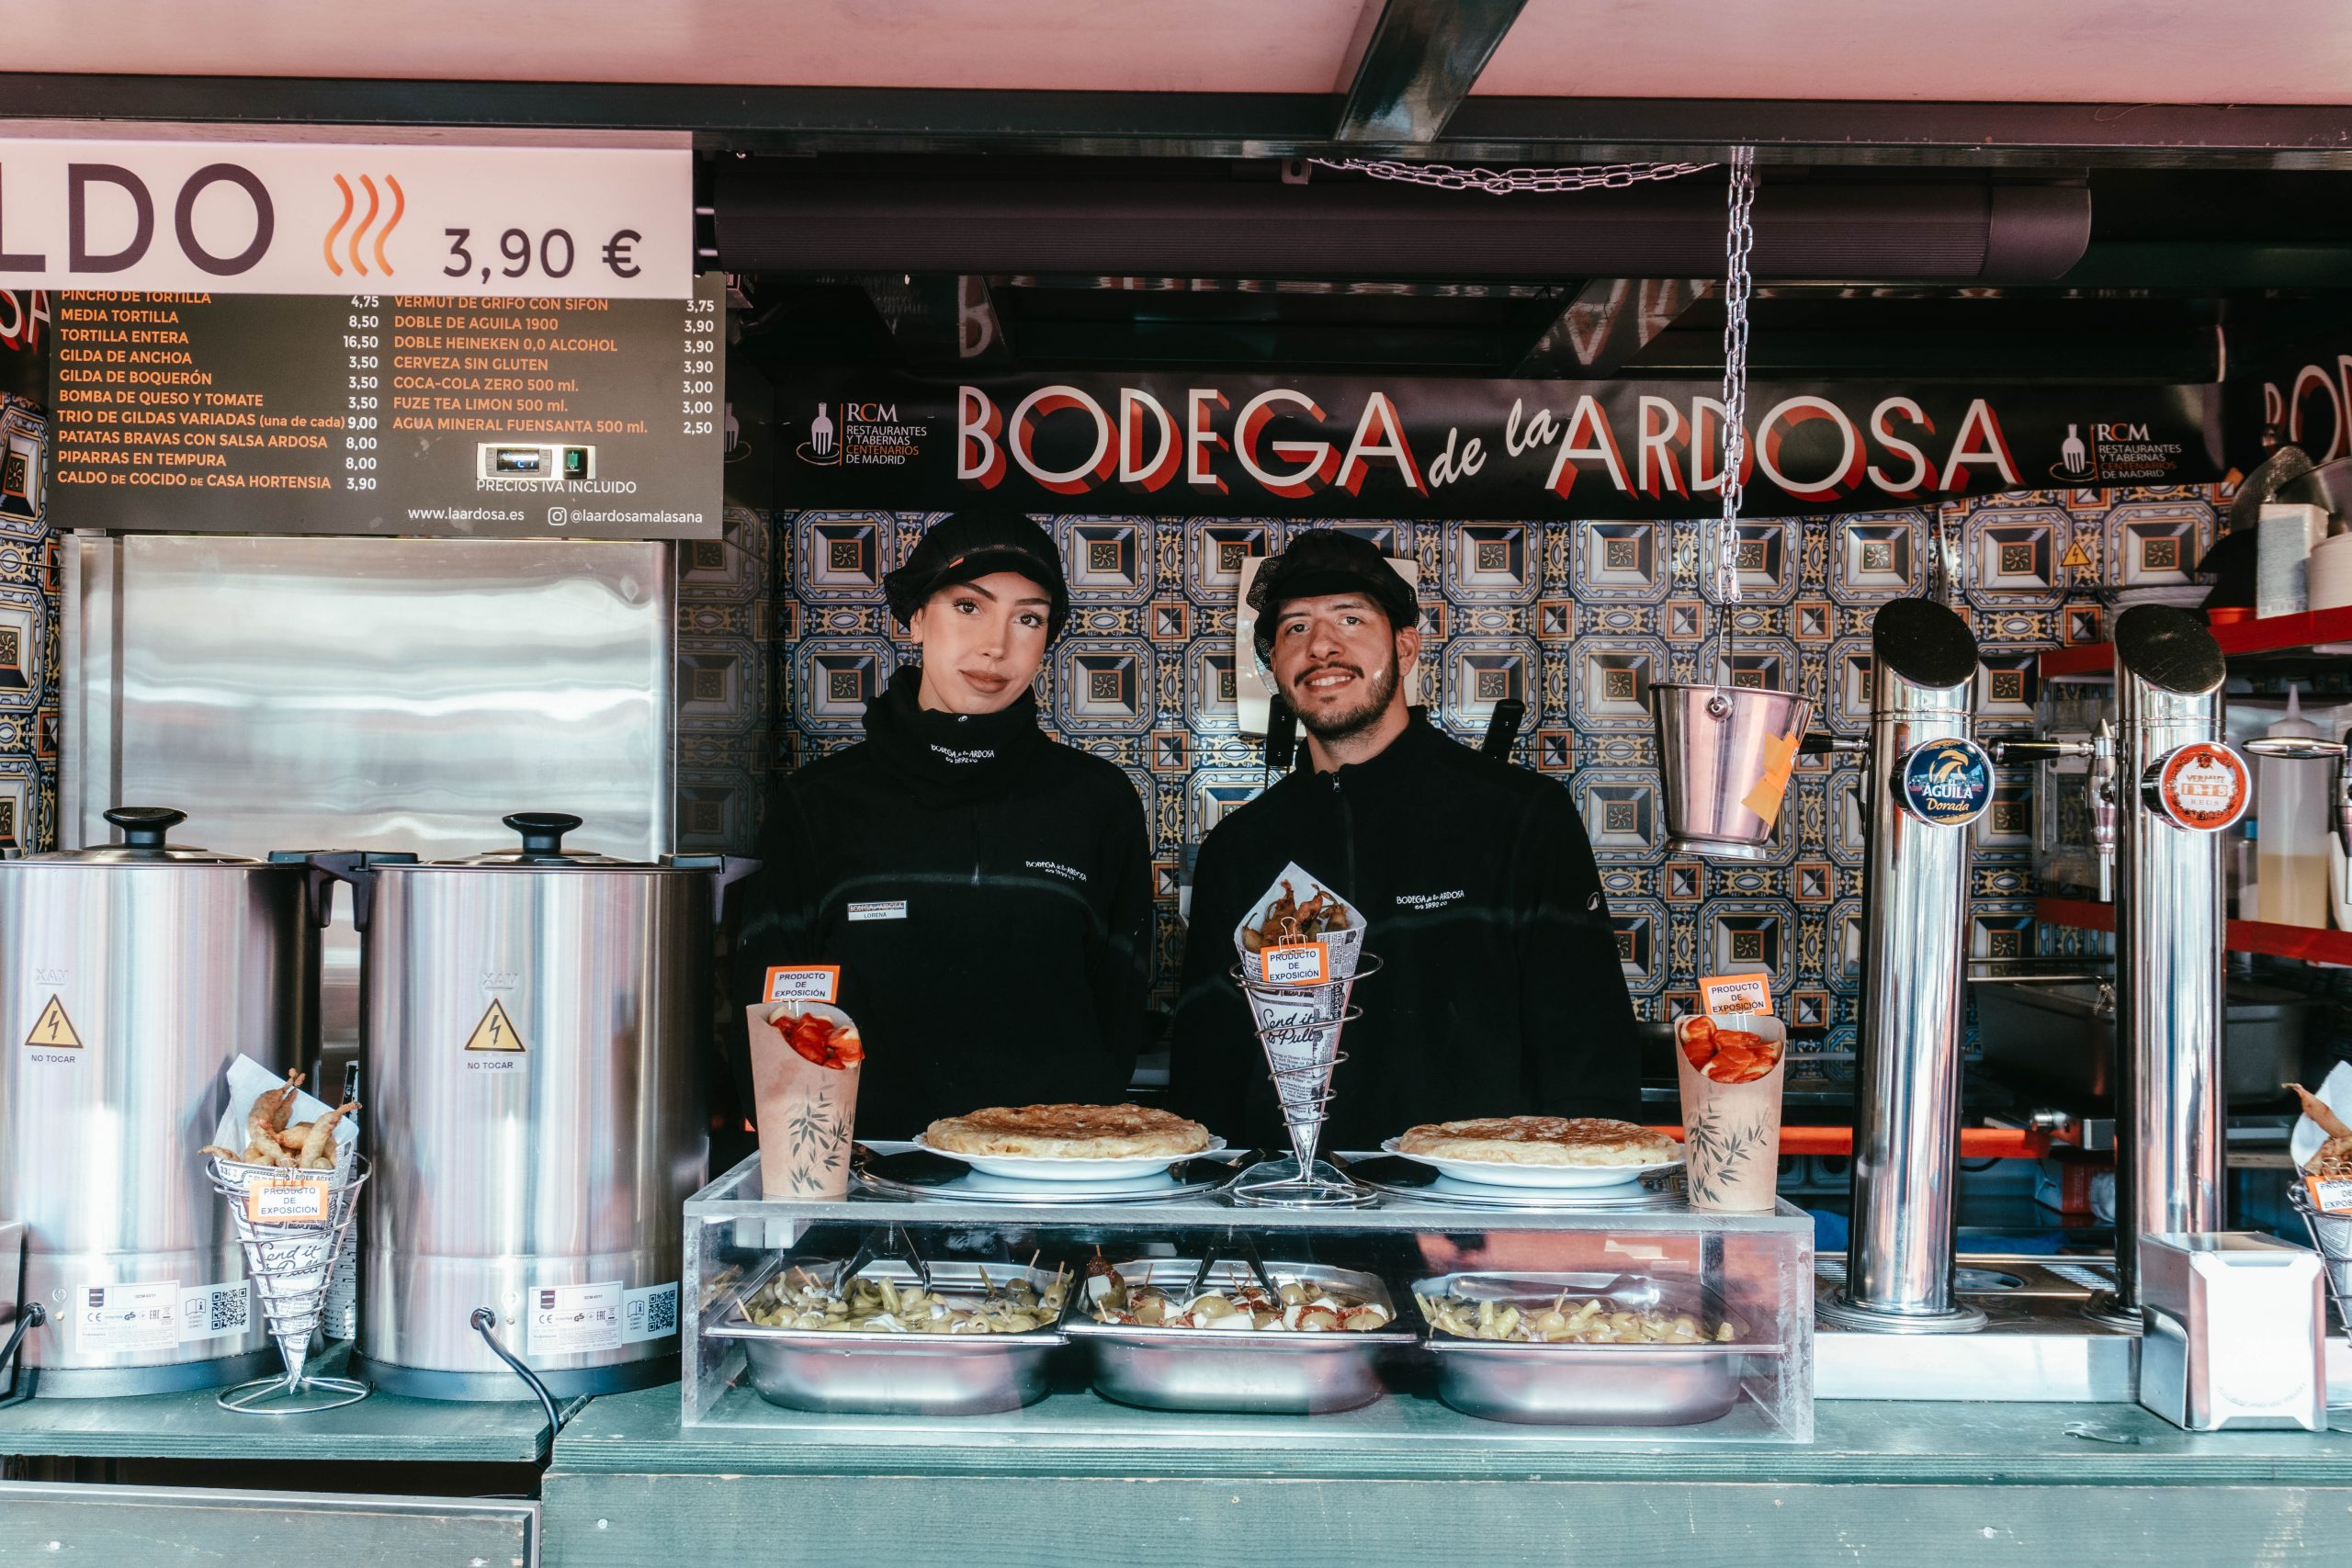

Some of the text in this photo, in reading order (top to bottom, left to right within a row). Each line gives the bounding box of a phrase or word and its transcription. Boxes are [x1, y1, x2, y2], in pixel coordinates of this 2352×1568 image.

[0, 162, 275, 276] LDO
[444, 227, 642, 285] 3,90 €
[62, 290, 379, 309] PINCHO DE TORTILLA 4,75
[395, 296, 454, 308] VERMUT
[459, 297, 477, 309] DE
[481, 298, 525, 310] GRIFO
[529, 299, 560, 310] CON
[686, 300, 714, 313] 3,75
[62, 309, 379, 329] MEDIA TORTILLA 8,50
[395, 316, 714, 333] DOBLE DE AGUILA 1900 3,90
[61, 329, 379, 349] TORTILLA ENTERA 16,50
[395, 336, 713, 354] DOBLE HEINEKEN 0,0 ALCOHOL 3,90
[60, 350, 378, 369] GILDA DE ANCHOA 3,50
[394, 356, 713, 375] CERVEZA SIN GLUTEN 3,90
[60, 369, 378, 390] GILDA DE BOQUERÓN 3,50
[394, 376, 713, 395] COCA-COLA ZERO 500 ml. 3,00
[60, 390, 378, 410] BOMBA DE QUESO Y TOMATE 3,50
[394, 397, 712, 414] FUZE TEA LIMON 500 ml. 3,00
[58, 411, 377, 430] TRIO DE GILDAS VARIADAS (una de cada) 9,00
[846, 402, 899, 423] RCM
[393, 417, 712, 434] AGUA MINERAL FUENSANTA 500 ml. 2,50
[846, 425, 927, 436] RESTAURANTES
[2098, 423, 2150, 441] RCM
[59, 431, 377, 450] PATATAS BRAVAS CON SALSA ARDOSA 8,00
[846, 435, 910, 446] Y TABERNAS
[957, 384, 2028, 502] BODEGA de la ARDOSA
[846, 445, 919, 456] CENTENARIOS
[2098, 444, 2182, 455] RESTAURANTES
[2110, 454, 2166, 462] TABERNAS
[59, 451, 377, 470] PIPARRAS EN TEMPURA 8,00
[846, 455, 905, 465] DE MADRID
[2101, 461, 2177, 471] CENTENARIOS
[58, 471, 376, 491] CALDO DE COCIDO DE CASA HORTENSIA 3,90
[2102, 469, 2165, 479] DE MADRID
[477, 480, 637, 493] PRECIOS IVA INCLUIDO
[408, 507, 702, 524] www.laardosa.es @laardosamalasana
[968, 750, 995, 758] ARDOSA
[1926, 797, 1970, 812] Dorada
[1396, 890, 1464, 904] BODEGA ARDOSA
[1270, 951, 1317, 962] PRODUCTO
[1269, 970, 1319, 981] EXPOSICIÓN
[1712, 982, 1759, 994] PRODUCTO
[1713, 999, 1764, 1013] EXPOSICIÓN
[1263, 1009, 1314, 1030] Send it
[46, 1055, 75, 1063] TOCAR
[482, 1061, 514, 1069] TOCAR
[261, 1205, 318, 1214] EXPOSICIÓN
[256, 1242, 322, 1264] Send it
